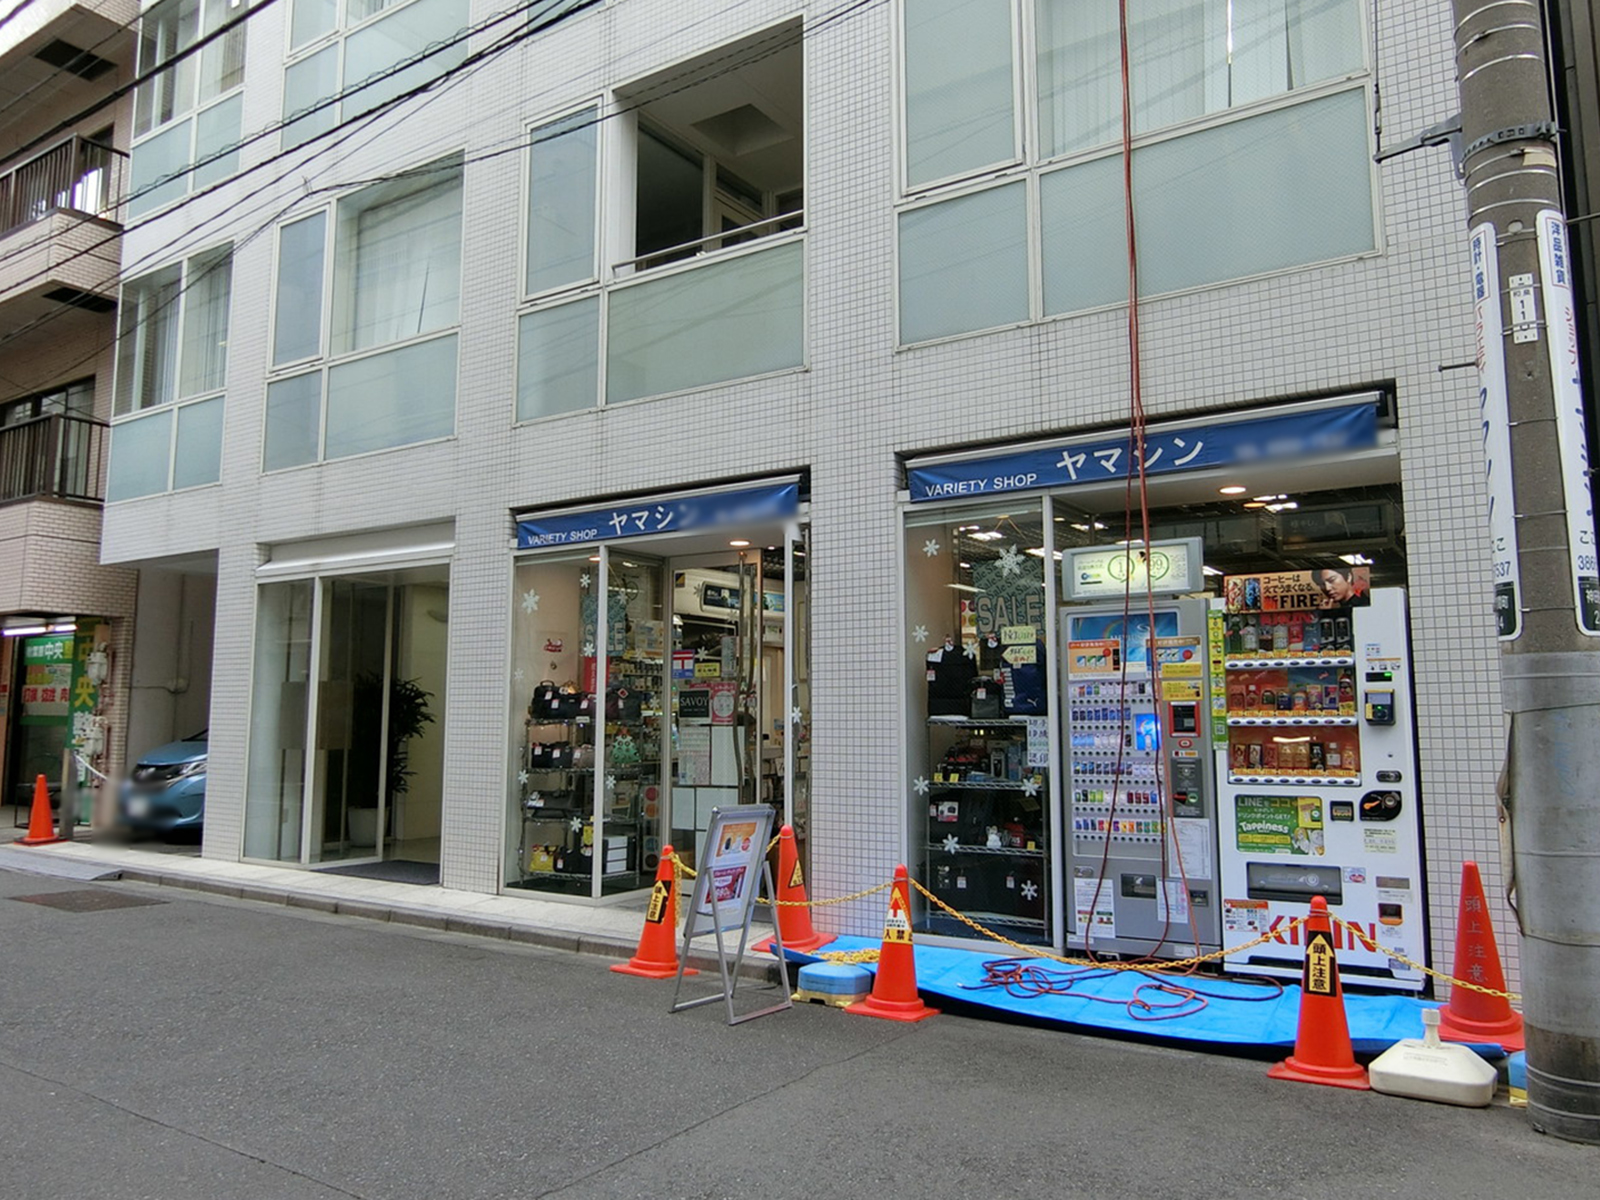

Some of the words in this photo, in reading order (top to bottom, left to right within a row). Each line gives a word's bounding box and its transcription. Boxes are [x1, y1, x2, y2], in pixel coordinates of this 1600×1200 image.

[925, 479, 988, 498] VARIETY
[993, 472, 1038, 492] SHOP
[1056, 437, 1204, 480] ヤマシン
[527, 531, 567, 546] VARIETY
[570, 528, 598, 542] SHOP
[1263, 574, 1301, 585] コーヒーは
[1280, 593, 1320, 609] FIRE
[680, 696, 709, 707] SAVOY
[1261, 914, 1377, 953] KIIN
[1464, 894, 1488, 983] 頭上注意
[1311, 942, 1327, 991] 頭上注意
